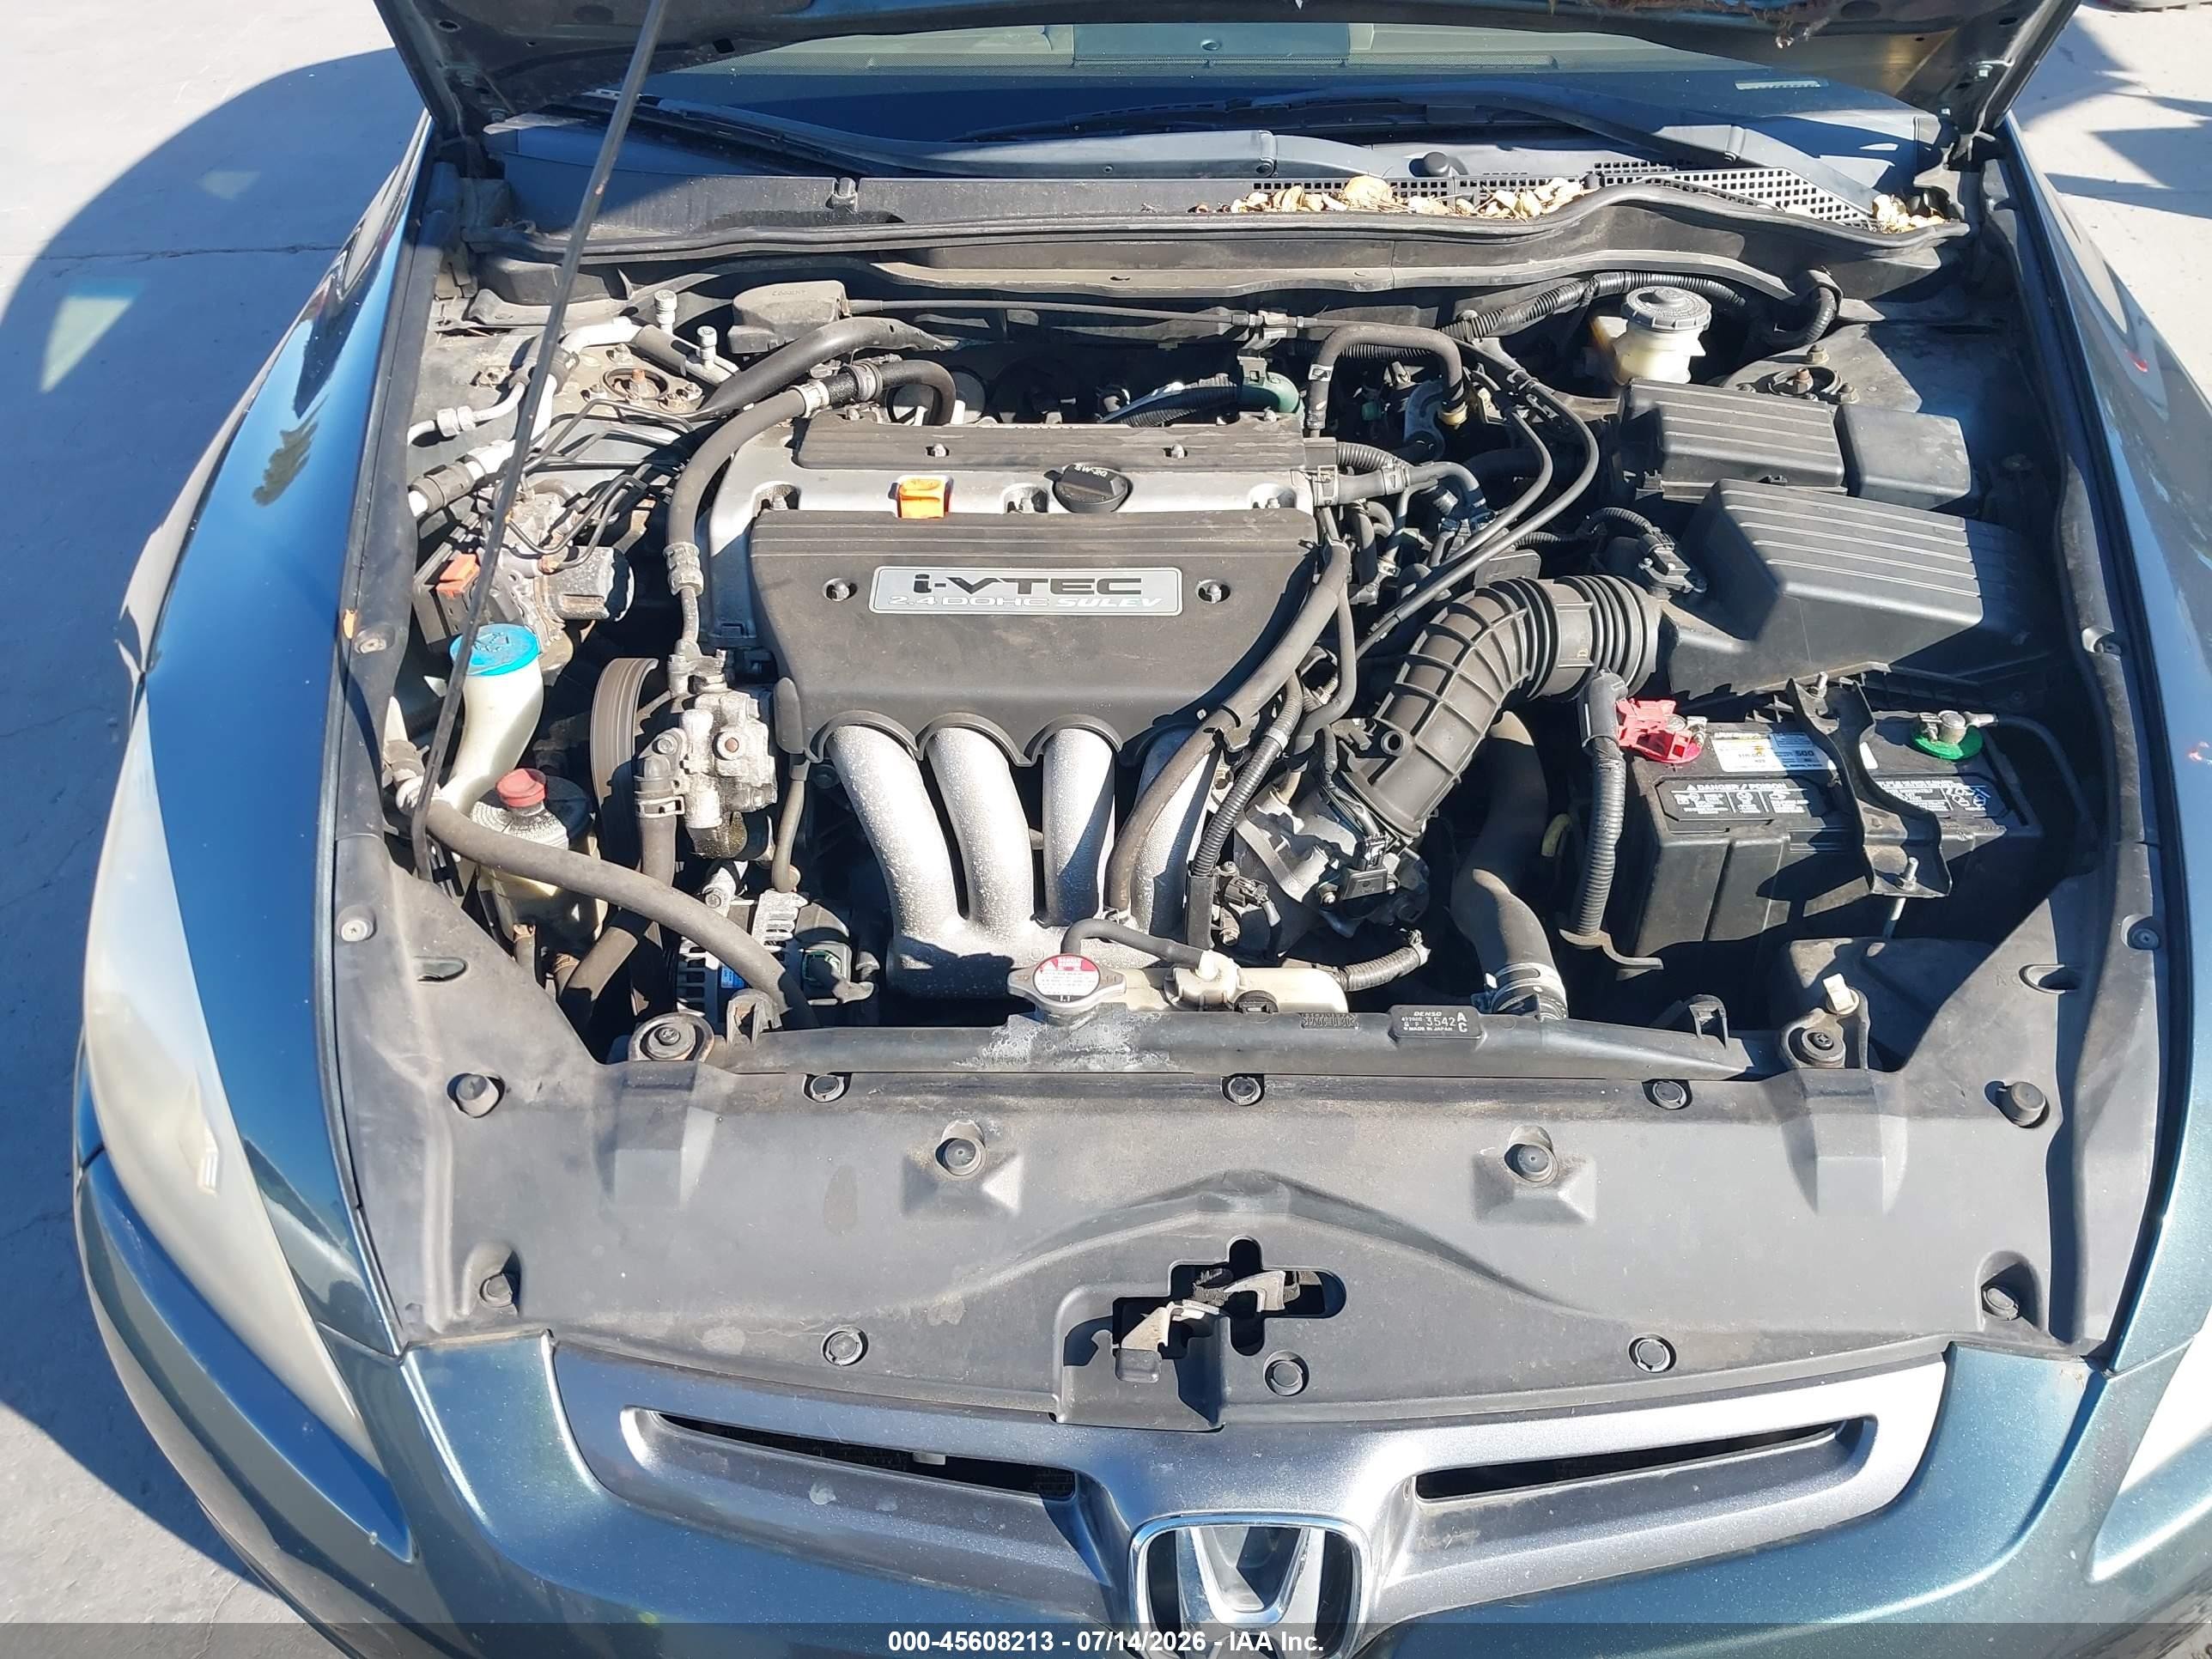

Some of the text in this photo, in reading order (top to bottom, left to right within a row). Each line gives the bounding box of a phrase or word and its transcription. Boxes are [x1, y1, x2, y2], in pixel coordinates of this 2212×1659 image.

[1073, 464, 1108, 477] 5W-20
[913, 574, 1142, 596] i-VTEC
[889, 596, 1164, 608] 2.4 DOHC SULEV
[1425, 1017, 1456, 1026] 3542
